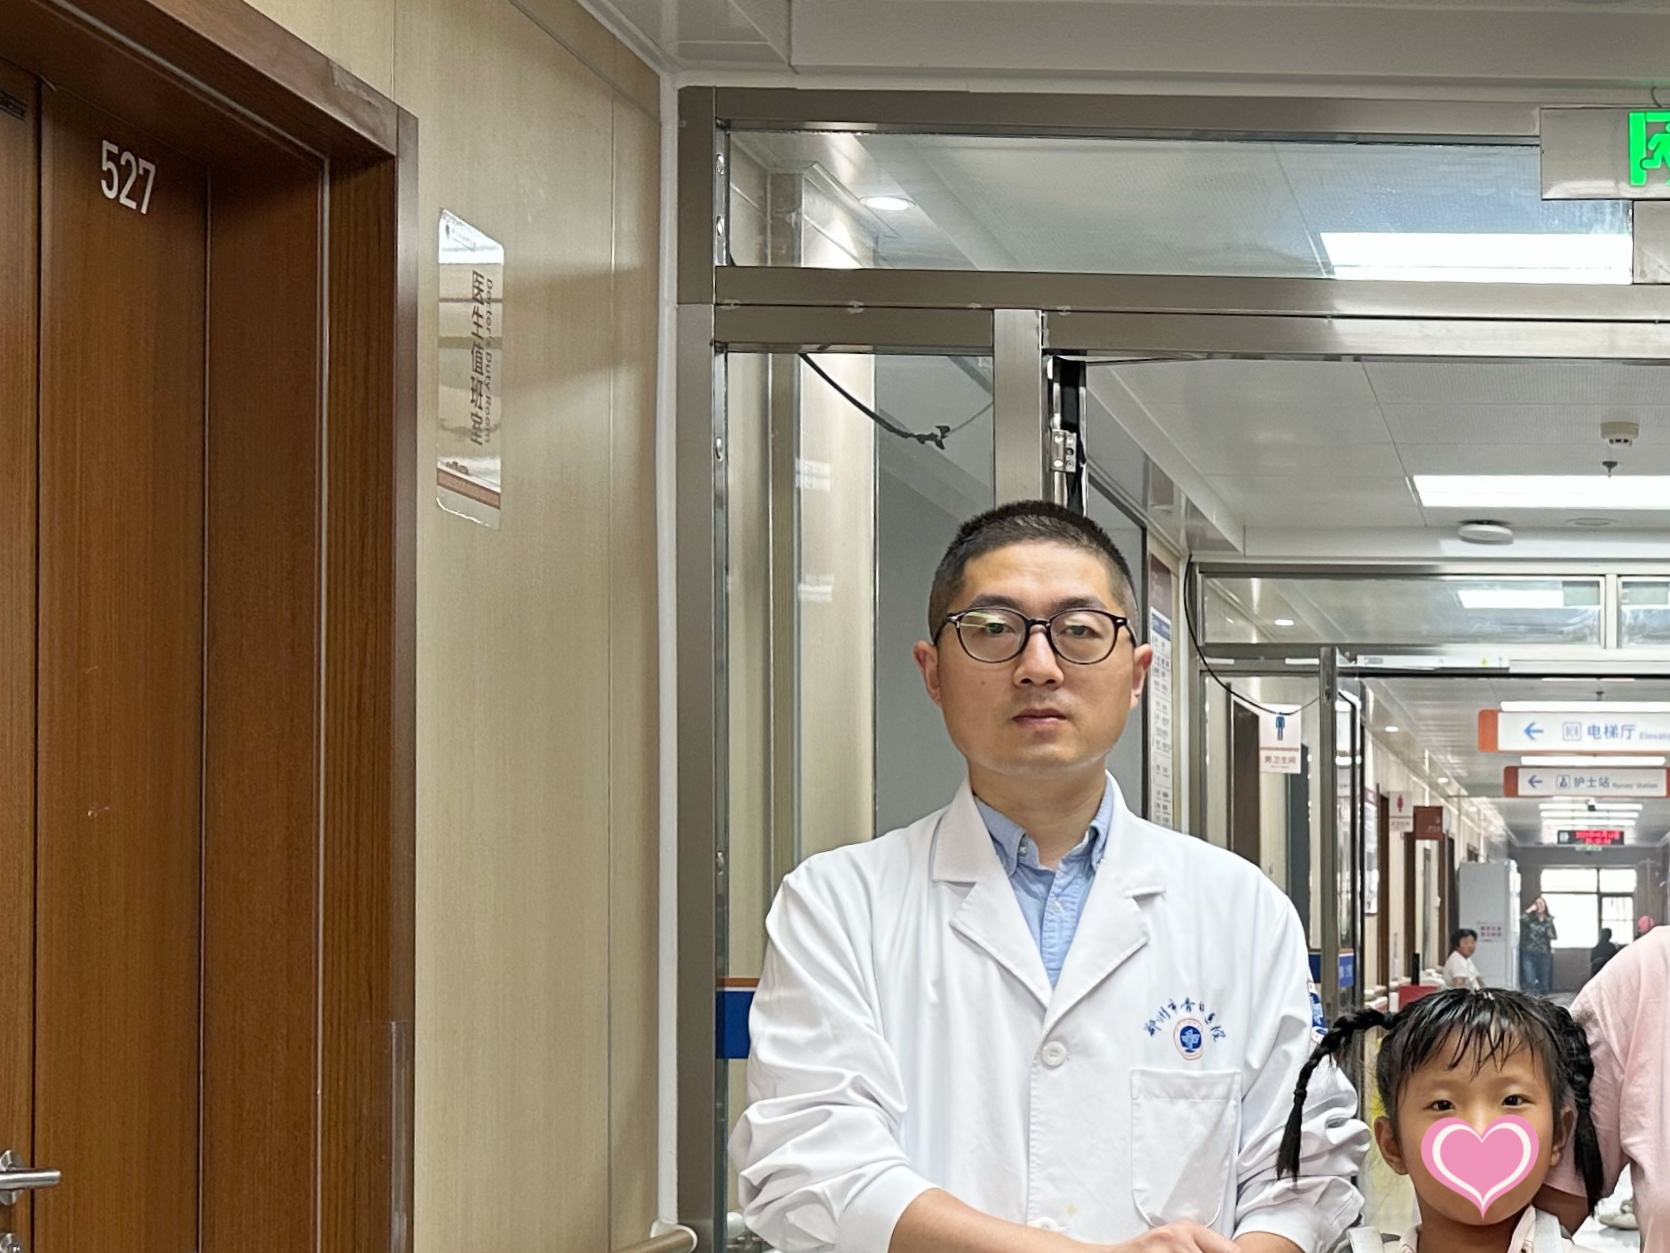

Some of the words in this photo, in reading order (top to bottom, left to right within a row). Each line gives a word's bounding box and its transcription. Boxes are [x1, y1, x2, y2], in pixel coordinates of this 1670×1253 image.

[100, 139, 157, 215] 527
[470, 269, 486, 446] 医生值班室
[484, 350, 493, 393] Duty
[484, 394, 492, 444] Room
[1587, 724, 1636, 740] 电梯厅
[1573, 776, 1611, 789] 护士站
